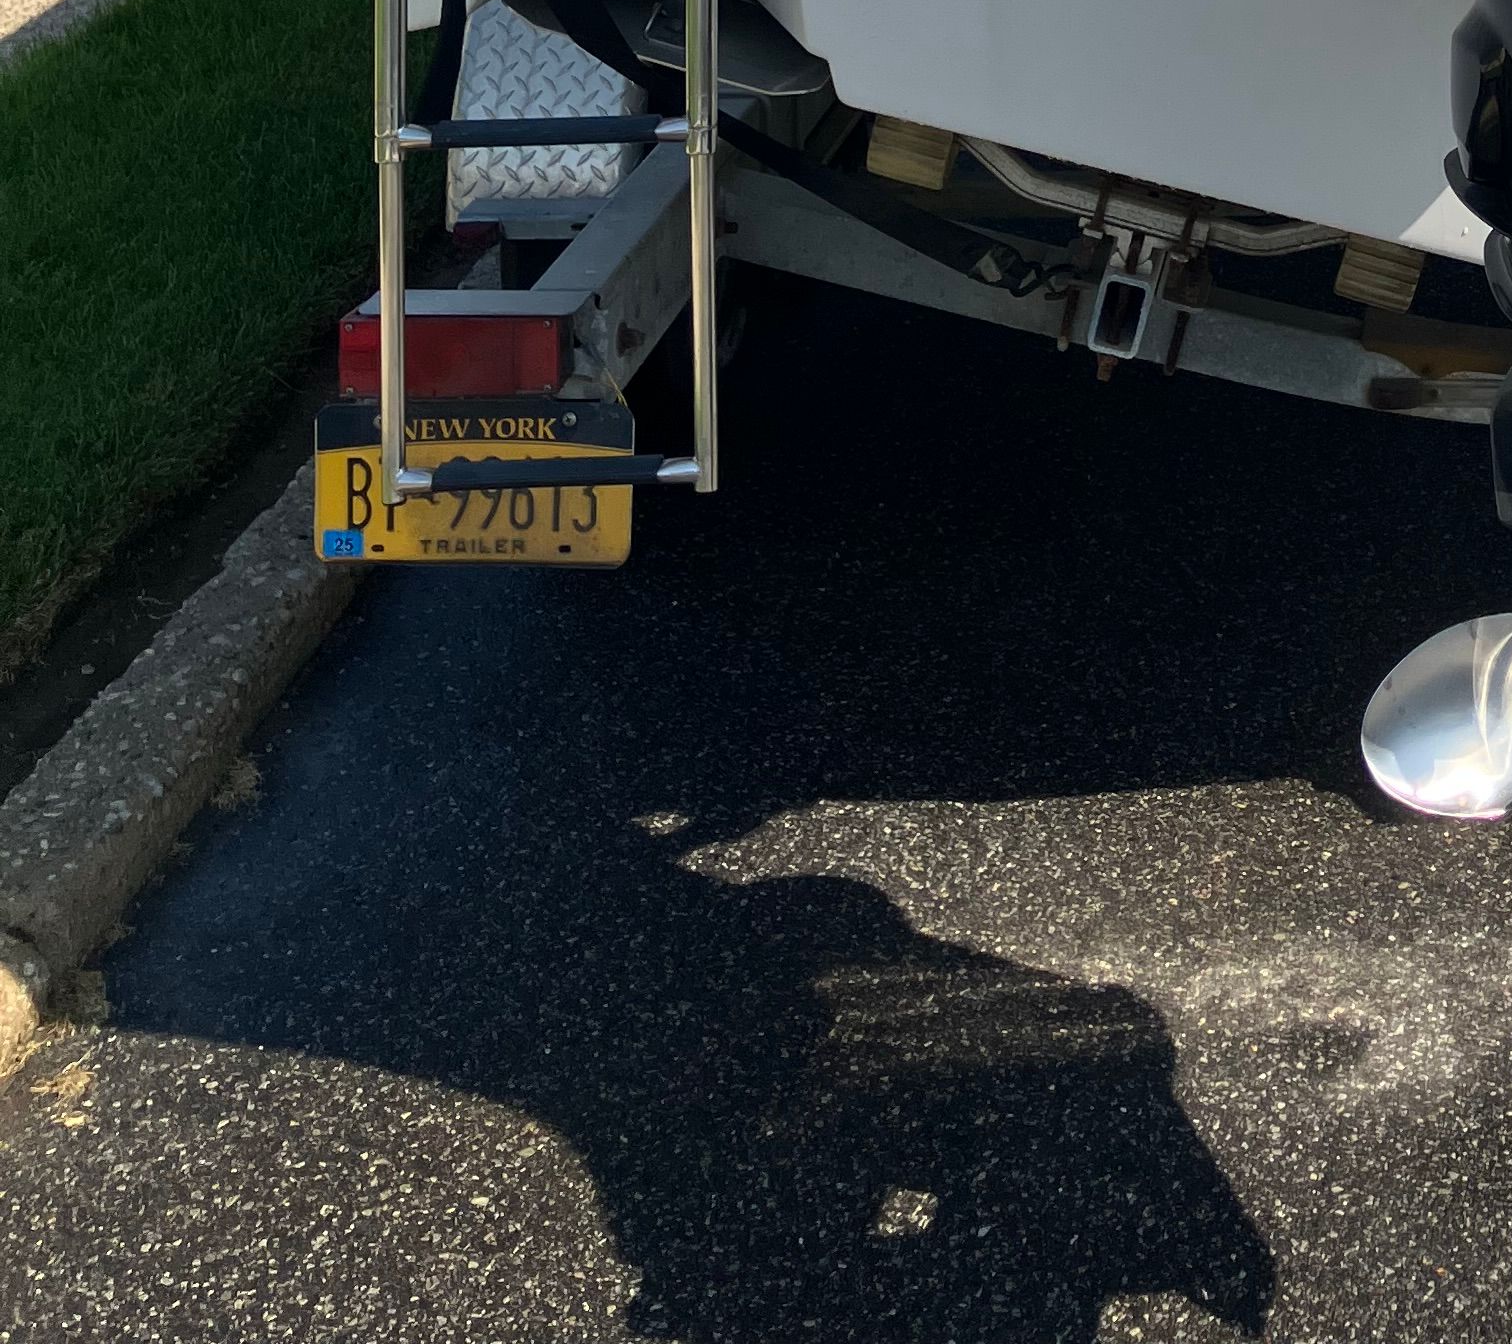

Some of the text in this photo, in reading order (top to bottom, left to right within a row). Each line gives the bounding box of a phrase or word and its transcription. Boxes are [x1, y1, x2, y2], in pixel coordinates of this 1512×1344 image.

[404, 417, 558, 441] NEW YORK
[335, 538, 354, 552] 25
[420, 539, 526, 554] TRAILER
